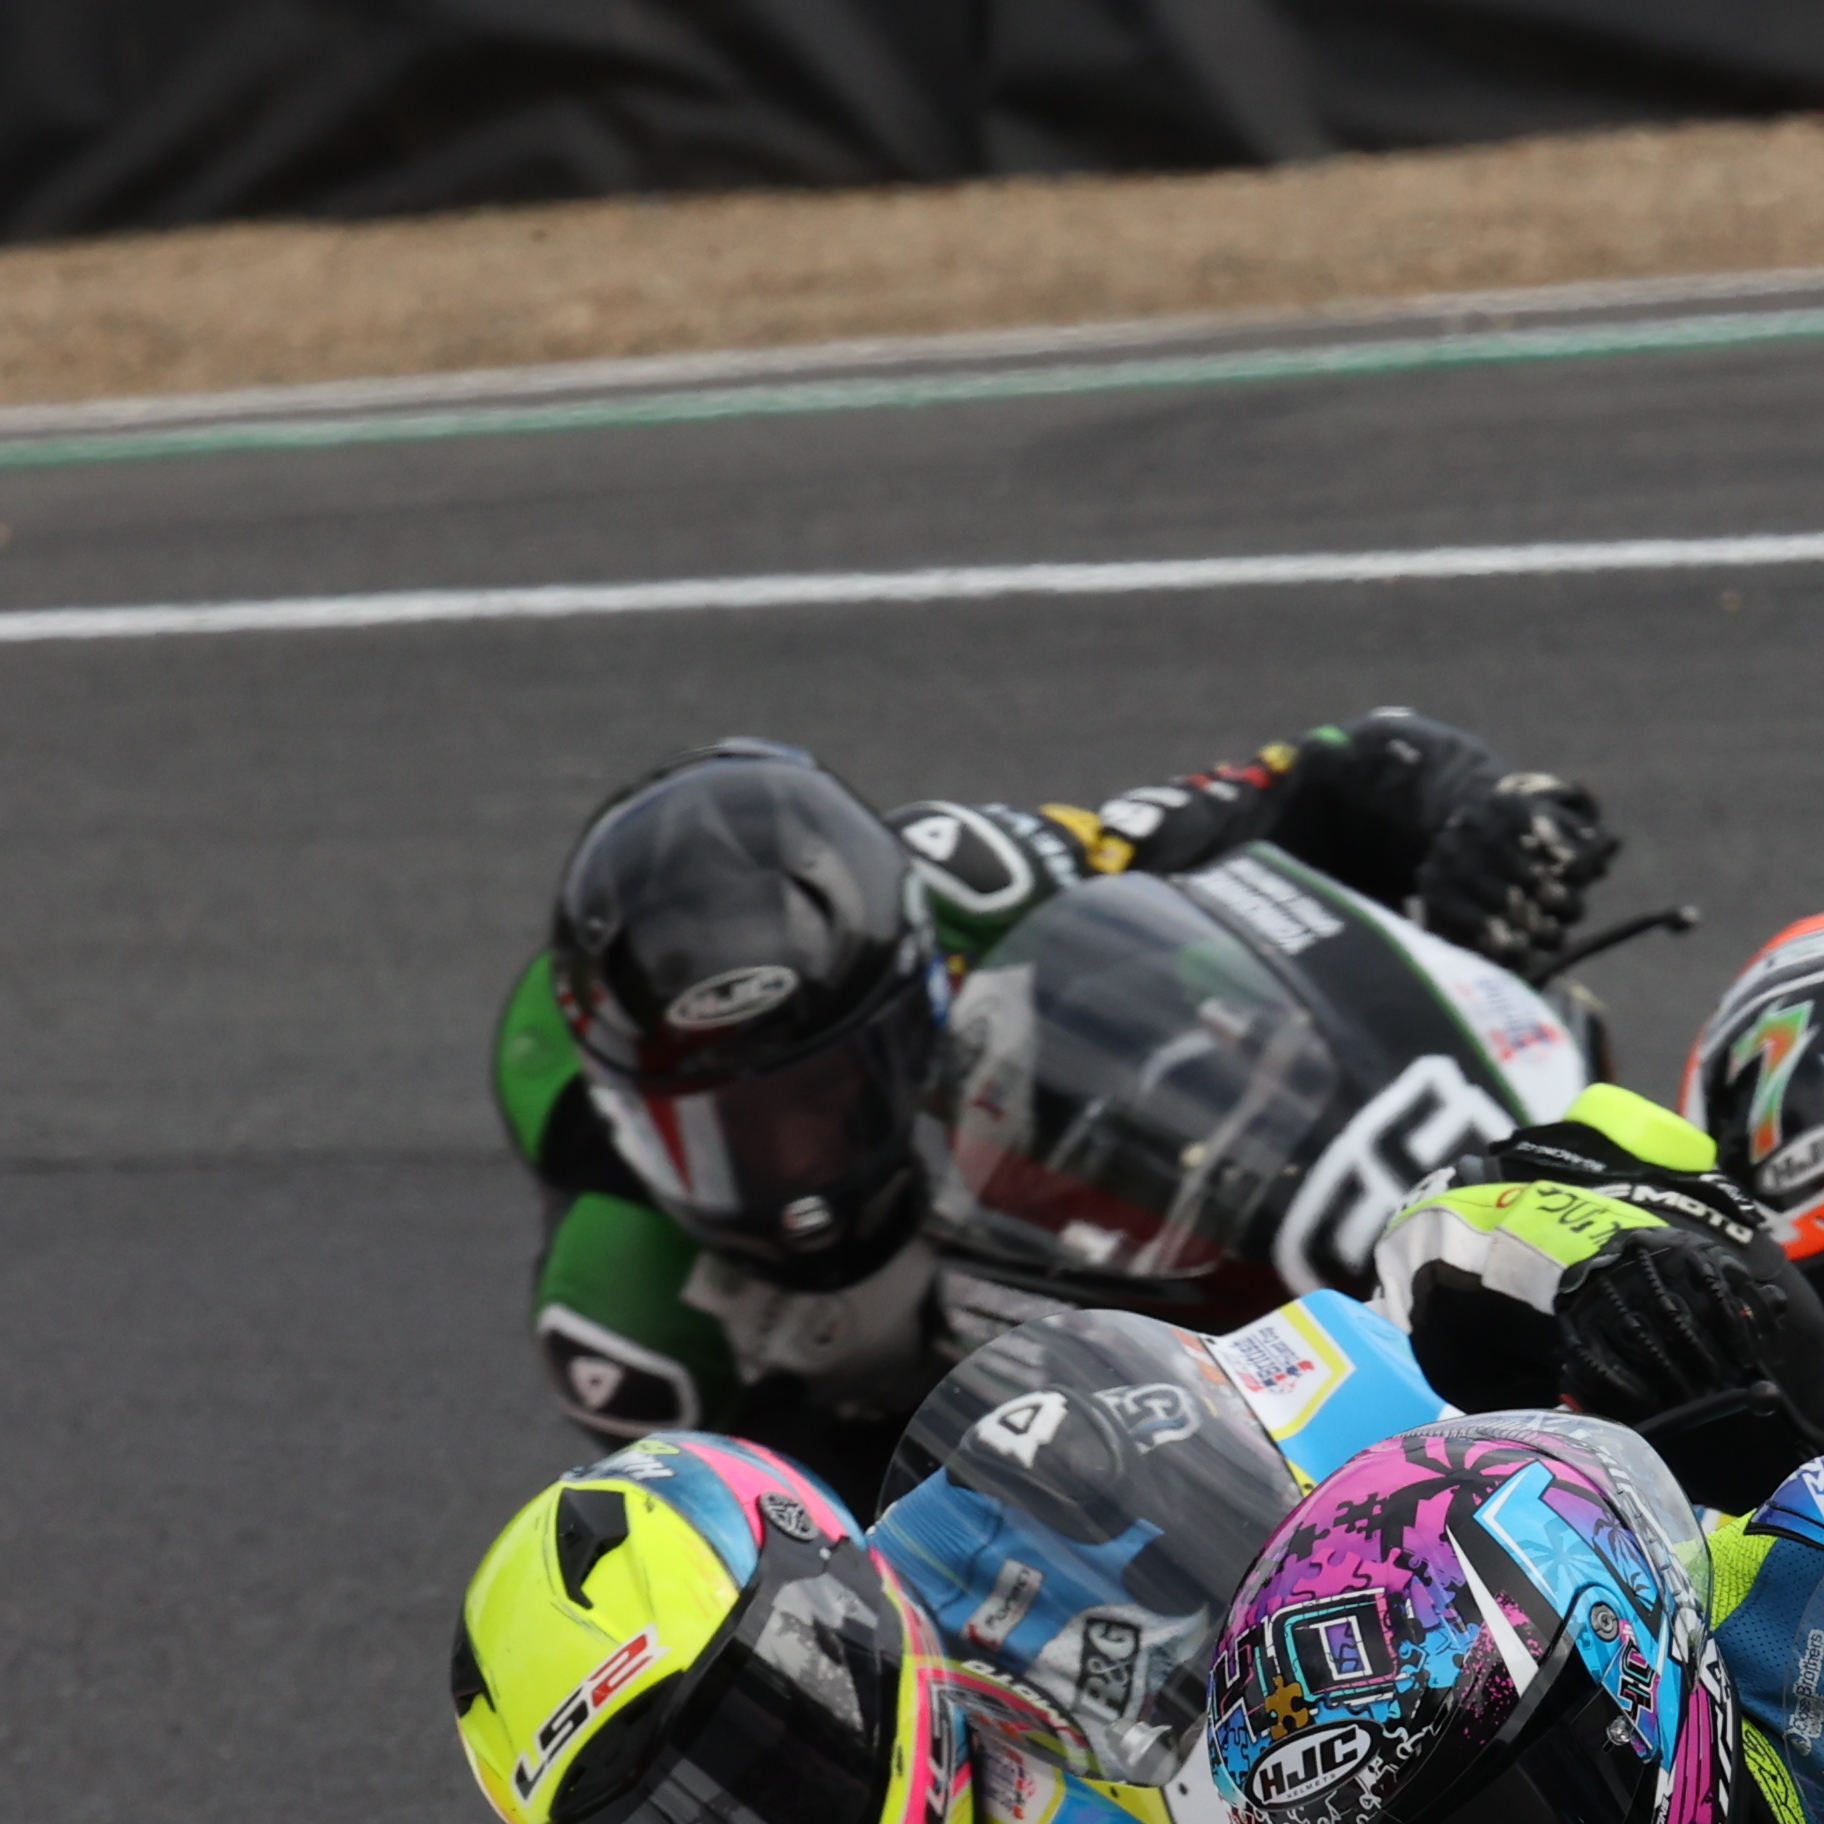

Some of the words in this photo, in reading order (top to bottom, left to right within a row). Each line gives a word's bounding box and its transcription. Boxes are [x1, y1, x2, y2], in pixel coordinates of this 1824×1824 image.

[515, 1632, 655, 1801] LS2
[1258, 1725, 1362, 1803] HJC
[1286, 1773, 1337, 1800] HELMETS
